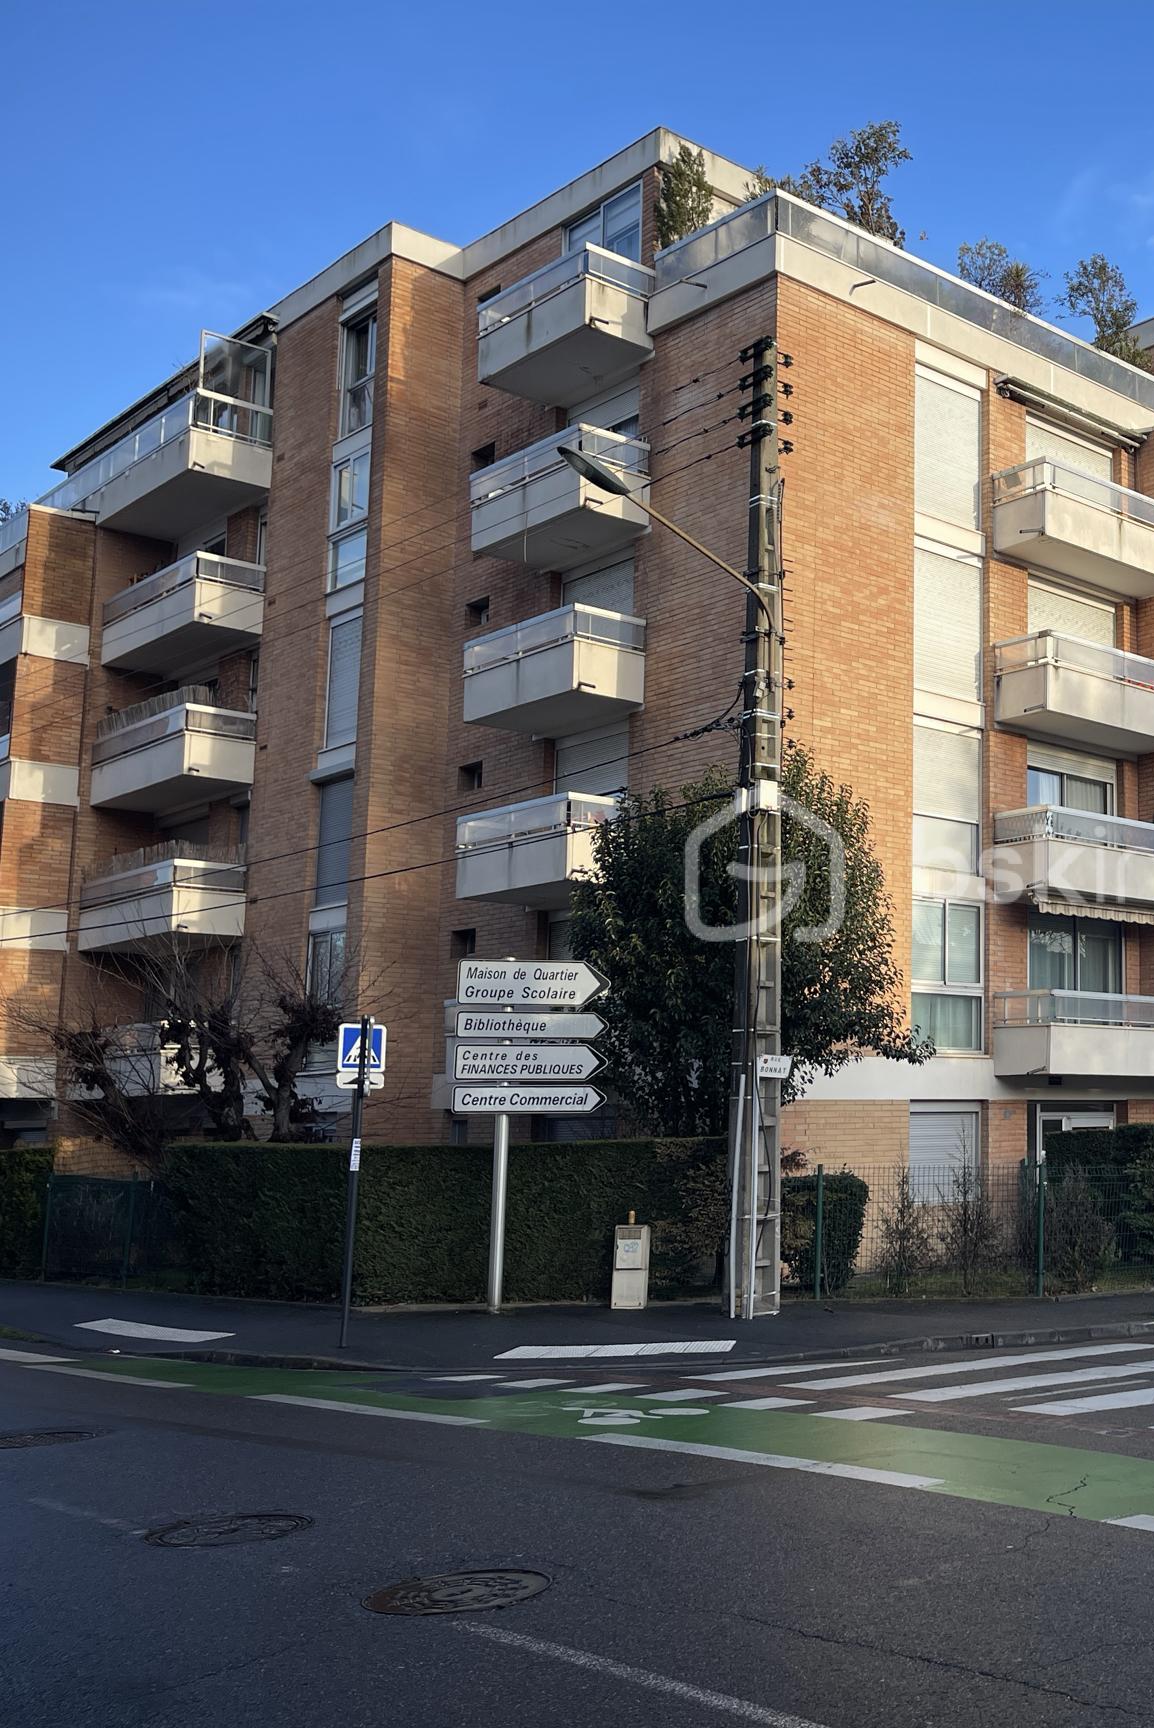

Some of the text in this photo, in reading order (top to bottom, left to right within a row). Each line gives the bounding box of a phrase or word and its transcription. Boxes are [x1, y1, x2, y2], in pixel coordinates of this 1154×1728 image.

[466, 967, 579, 981] Maison de Quartier
[465, 986, 576, 1001] Groupe Scolaire
[464, 1018, 547, 1035] Bibliothèque
[462, 1050, 538, 1061] Centre des
[460, 1064, 584, 1075] FINANCES PUBLIQUES
[461, 1093, 588, 1106] Centre Commercial
